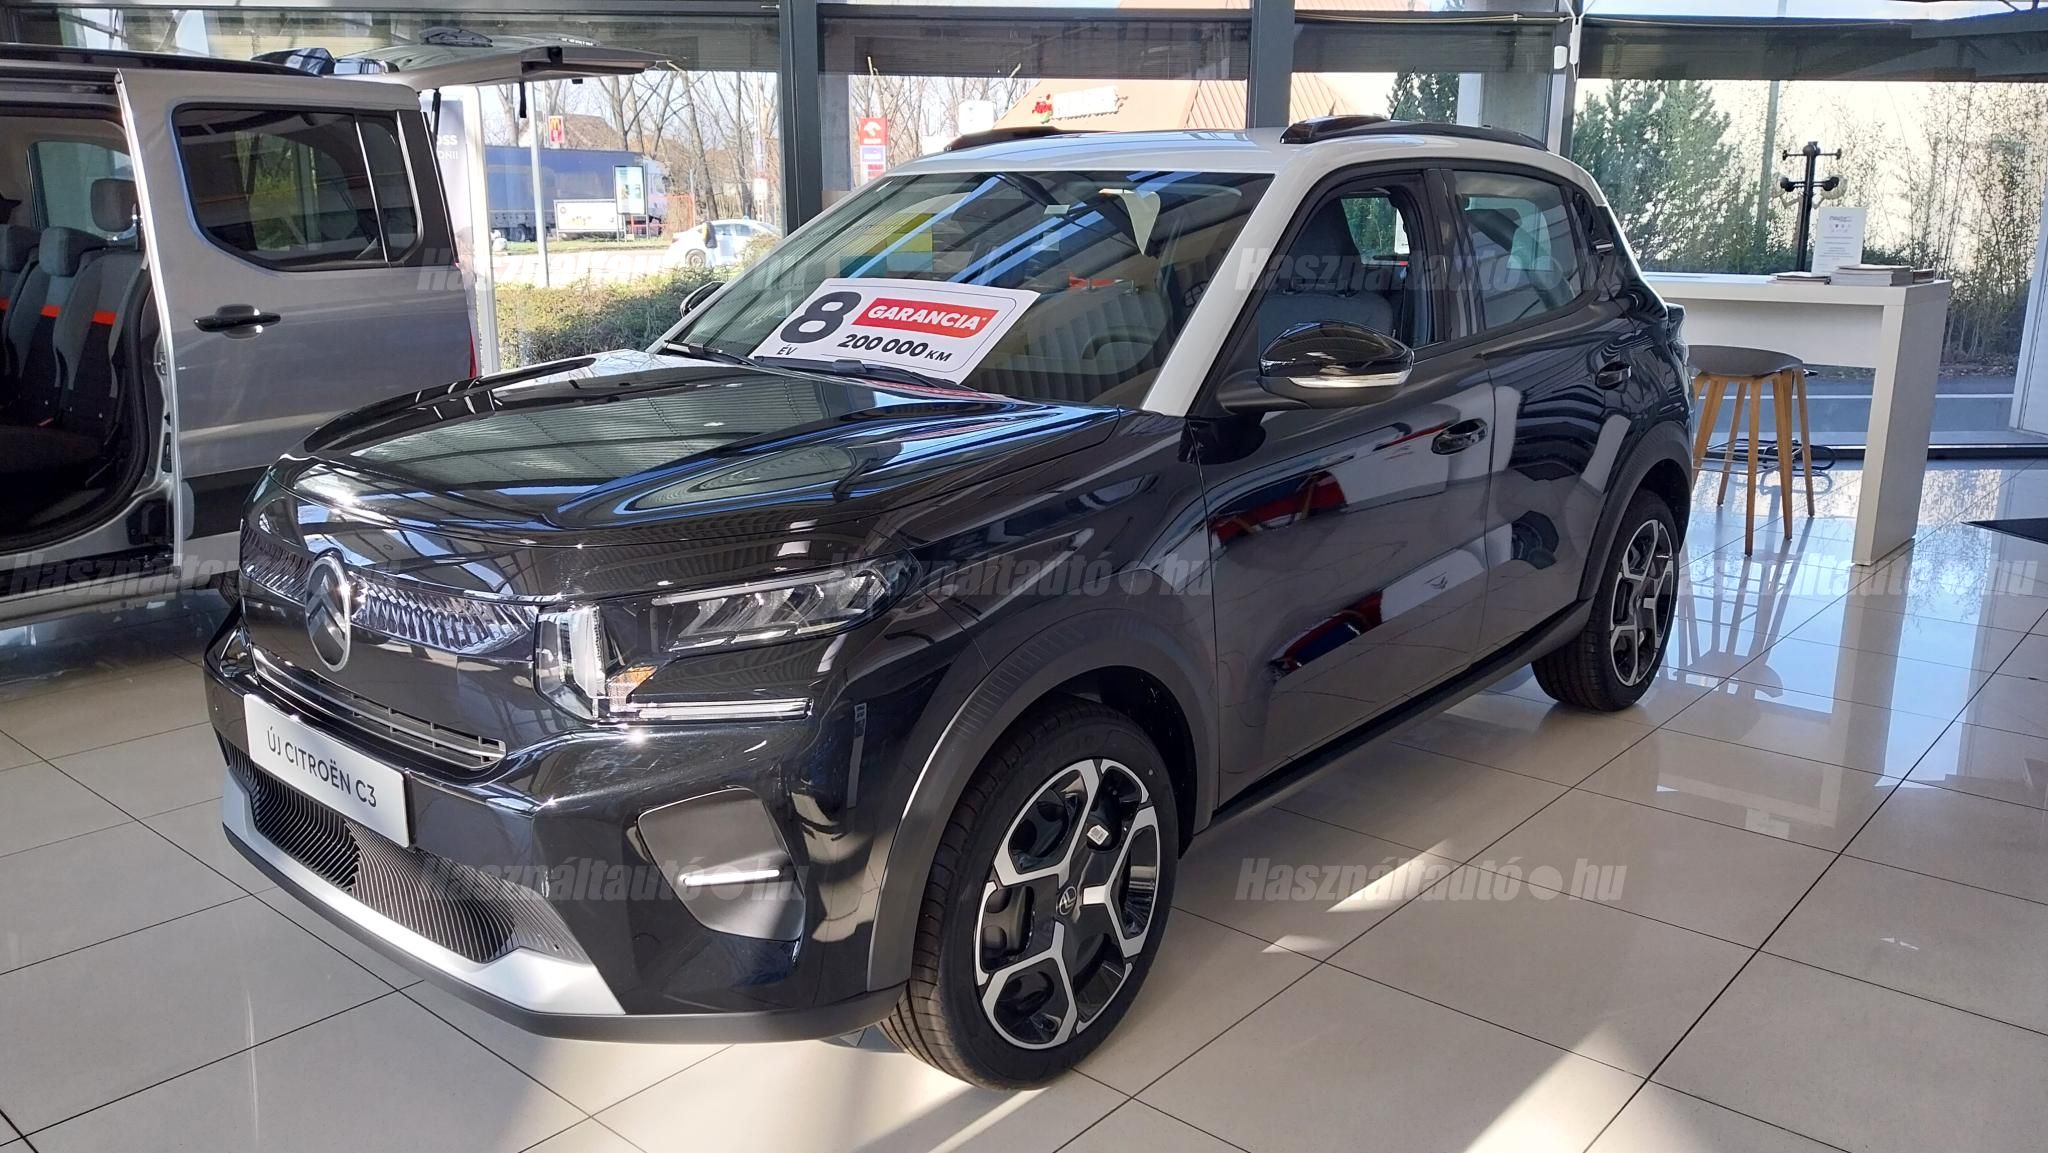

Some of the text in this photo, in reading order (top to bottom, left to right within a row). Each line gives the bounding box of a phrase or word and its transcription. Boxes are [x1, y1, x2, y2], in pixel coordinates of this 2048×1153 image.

[780, 291, 862, 344] 8
[776, 344, 799, 357] ÉV
[924, 350, 953, 363] KM
[266, 726, 377, 808] ÚJ CITROËN C3
